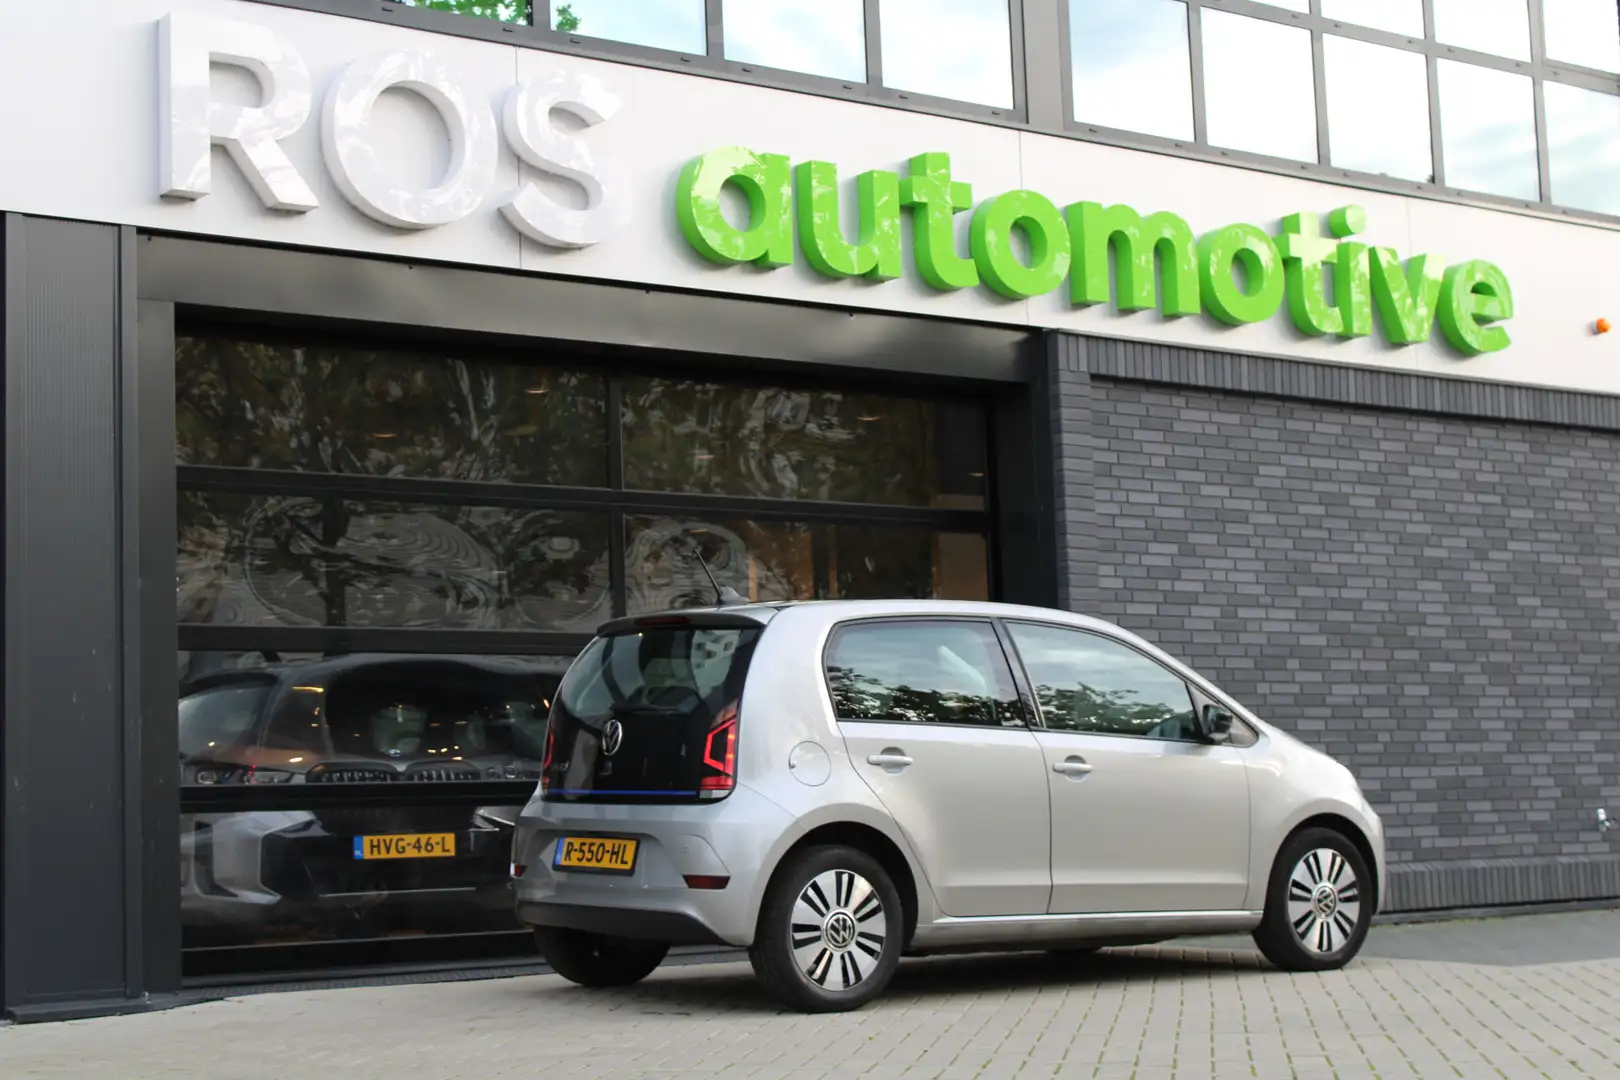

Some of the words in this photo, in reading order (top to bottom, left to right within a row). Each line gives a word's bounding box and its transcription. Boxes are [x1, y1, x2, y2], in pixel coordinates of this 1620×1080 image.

[158, 12, 630, 249] ROS
[676, 144, 1513, 354] automotive
[369, 836, 451, 856] HVG-46-L
[564, 841, 629, 865] R-550-HL
